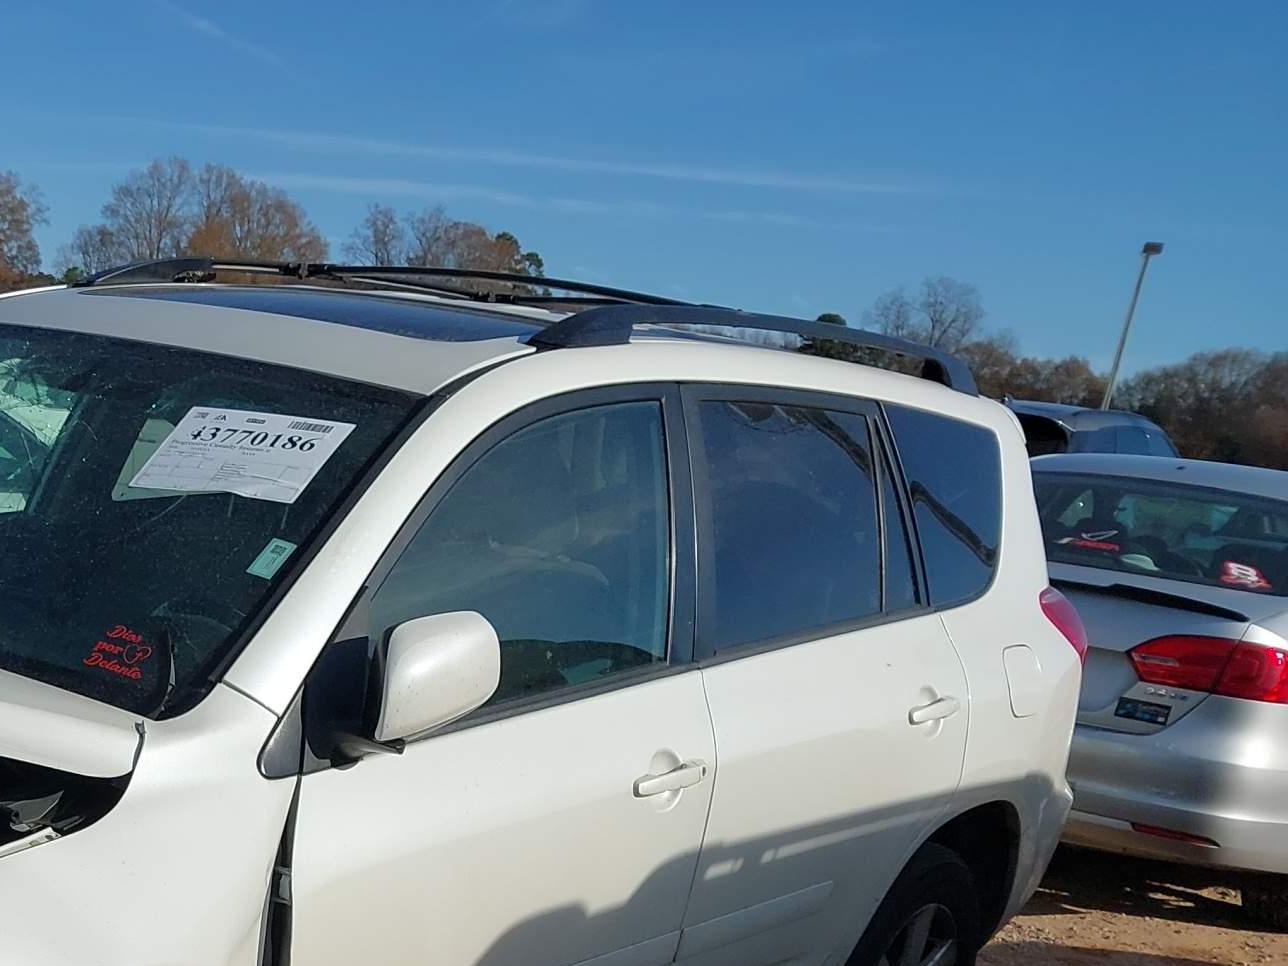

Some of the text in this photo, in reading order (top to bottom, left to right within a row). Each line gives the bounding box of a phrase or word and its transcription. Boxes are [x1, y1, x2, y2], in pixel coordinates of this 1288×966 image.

[191, 425, 320, 452] 43770186
[106, 624, 143, 643] Dios
[94, 641, 124, 654] por
[83, 652, 142, 679] Delante
